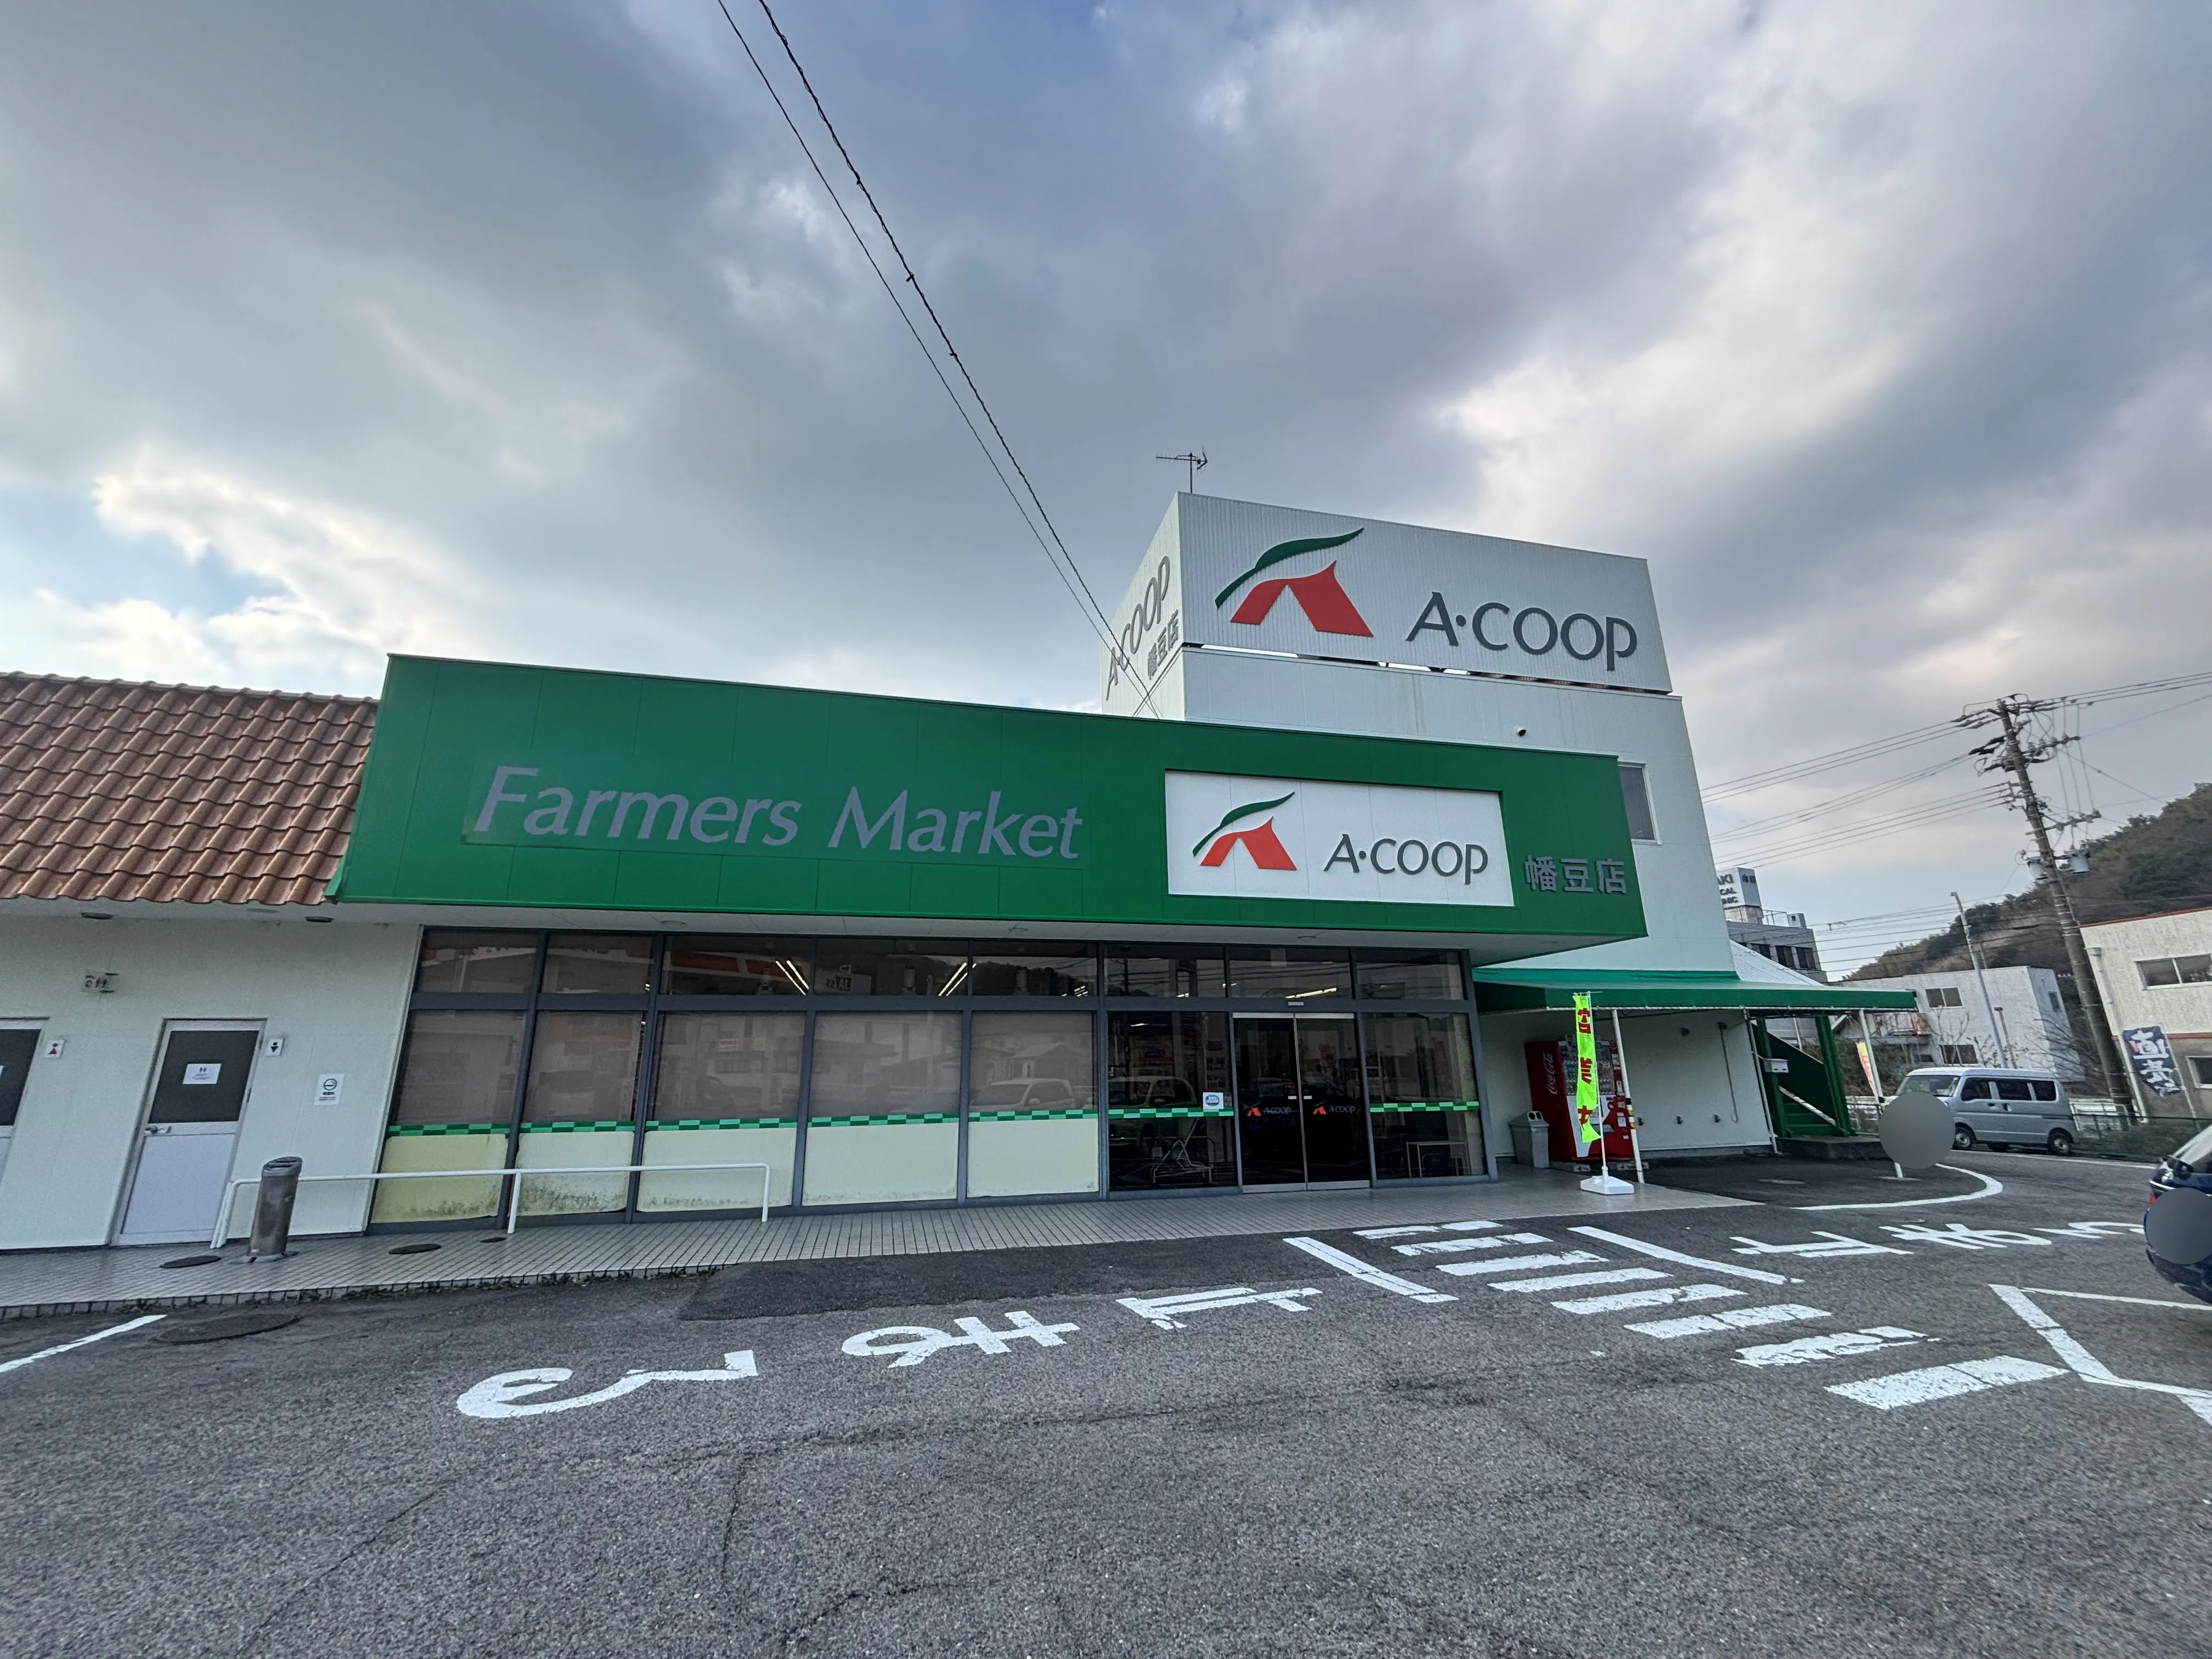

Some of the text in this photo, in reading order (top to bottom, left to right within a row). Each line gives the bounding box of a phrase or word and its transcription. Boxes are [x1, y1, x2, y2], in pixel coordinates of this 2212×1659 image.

[473, 765, 1083, 859] Farmers Market
[1523, 854, 1627, 895] 幡豆店
